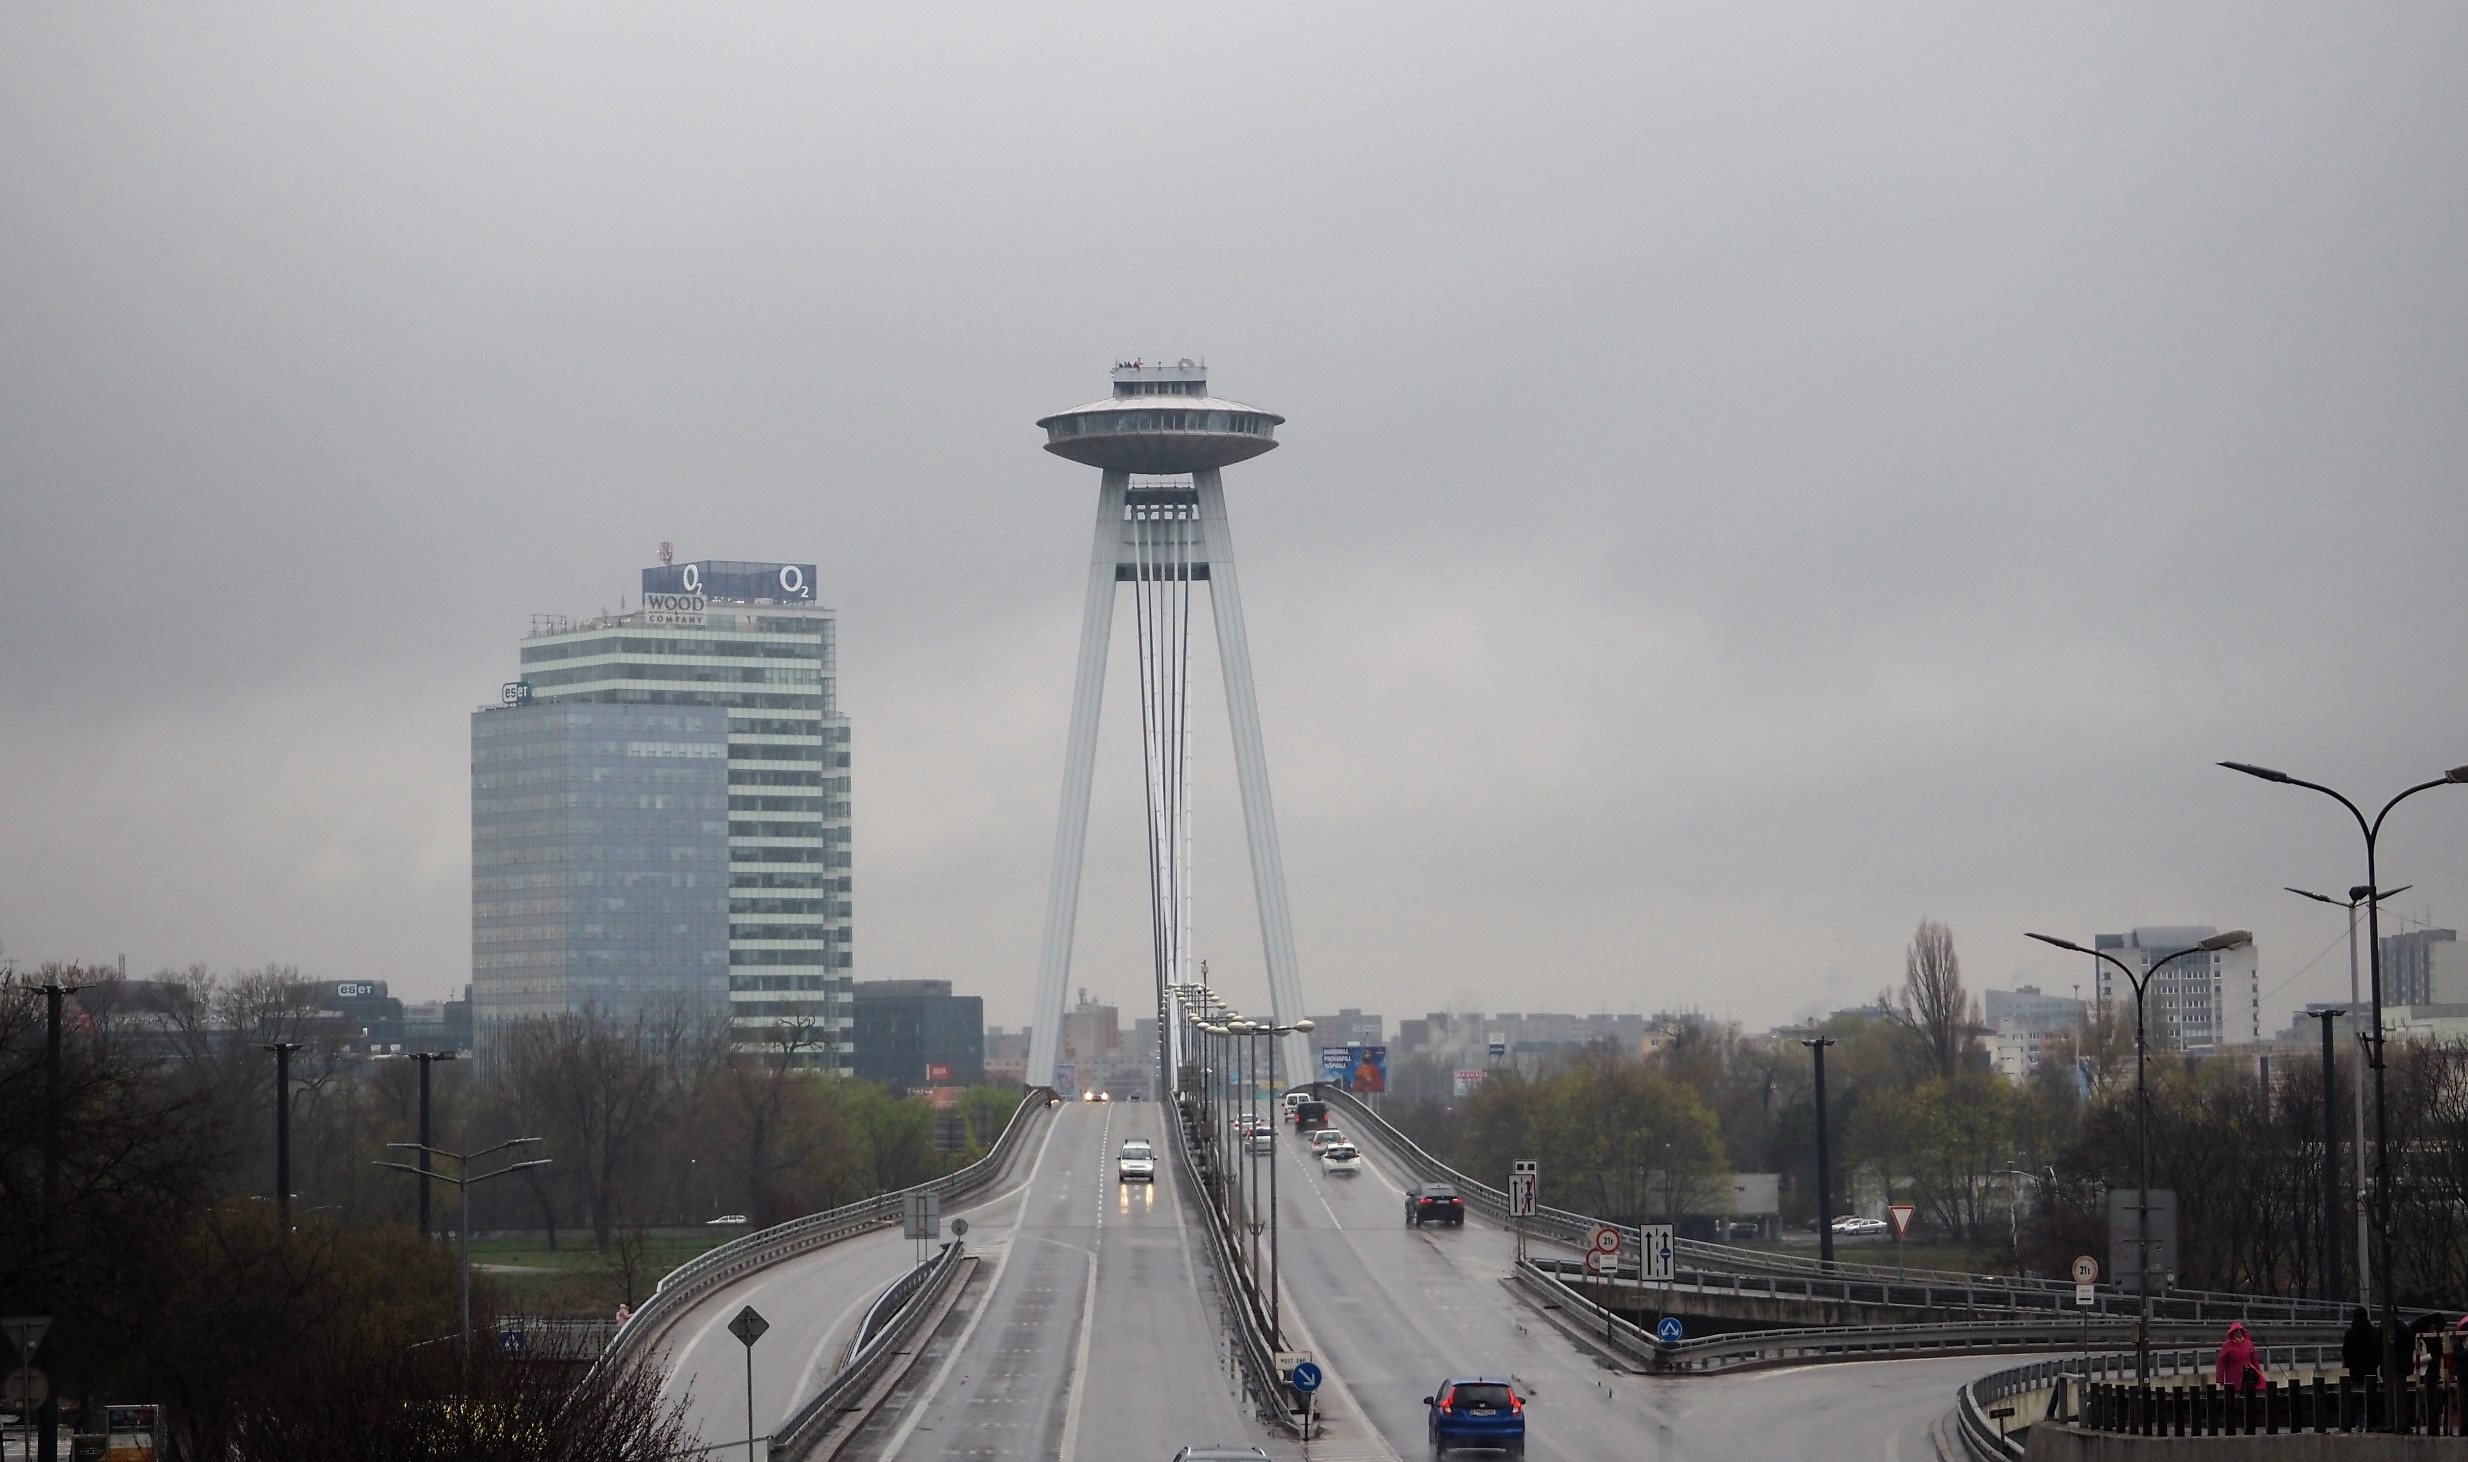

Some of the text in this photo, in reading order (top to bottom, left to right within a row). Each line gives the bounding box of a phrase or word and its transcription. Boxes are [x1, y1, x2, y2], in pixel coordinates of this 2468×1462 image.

[647, 596, 704, 611] WOOD
[649, 614, 703, 623] COMPANY
[1457, 1071, 1488, 1079] BAUHAUS
[1603, 1236, 1613, 1245] 21t
